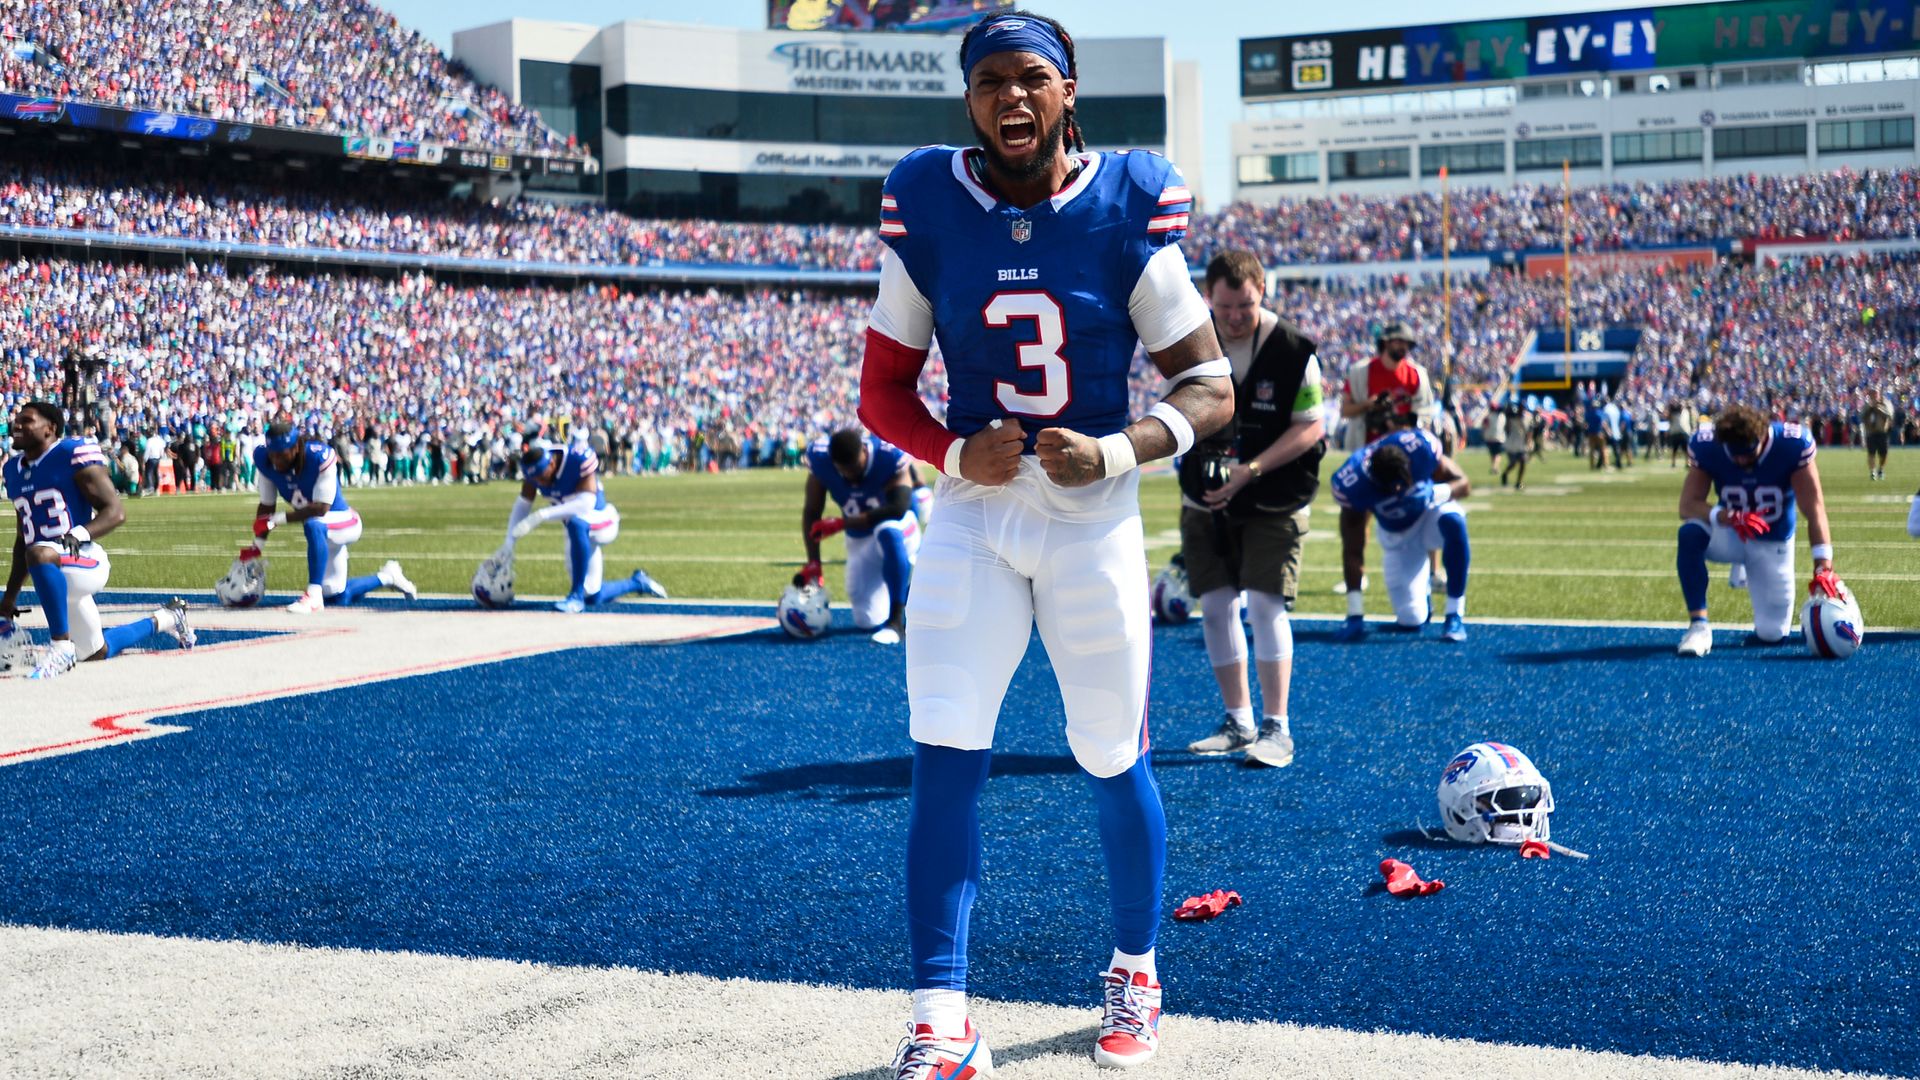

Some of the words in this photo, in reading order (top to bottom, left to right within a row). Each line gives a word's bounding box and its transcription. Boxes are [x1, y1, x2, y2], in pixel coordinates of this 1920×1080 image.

[793, 46, 944, 73] HIGHMARK
[795, 76, 862, 90] WESTERN
[867, 78, 900, 91] NEW
[905, 80, 945, 92] YORK
[756, 152, 810, 166] Official
[815, 155, 862, 167] Health
[997, 268, 1039, 281] BILLS
[983, 290, 1072, 418] 3
[1251, 401, 1276, 411] MEDIA
